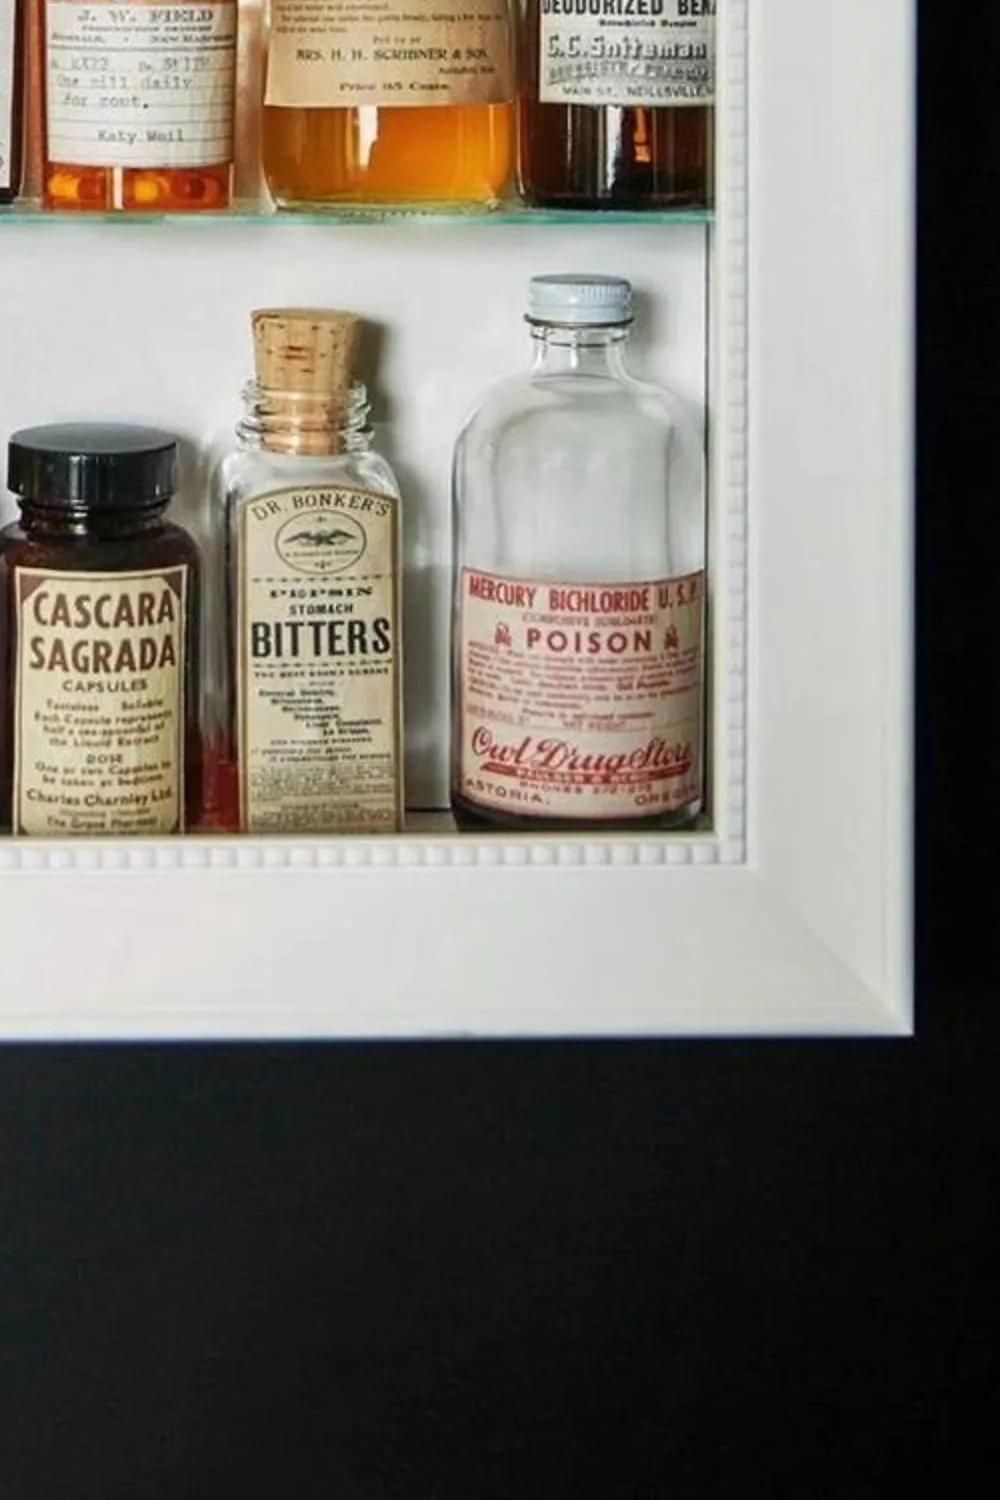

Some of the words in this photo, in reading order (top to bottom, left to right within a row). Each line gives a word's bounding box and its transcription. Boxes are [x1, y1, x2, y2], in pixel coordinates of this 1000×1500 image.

[148, 9, 214, 23] FIELD
[97, 130, 139, 145] Katy
[291, 492, 391, 518] BONKER'S
[468, 574, 538, 609] MERCURY
[549, 587, 650, 613] BICHLORIDE
[32, 587, 176, 630] CASCARA
[289, 602, 355, 616] STOMACH
[251, 615, 392, 659] BITTERS
[526, 627, 654, 655] POISON
[28, 632, 177, 675] SAGRADA
[61, 678, 149, 694] CAPSULES
[470, 725, 532, 765] Owl
[535, 736, 628, 772] Drug
[26, 786, 81, 806] Charles
